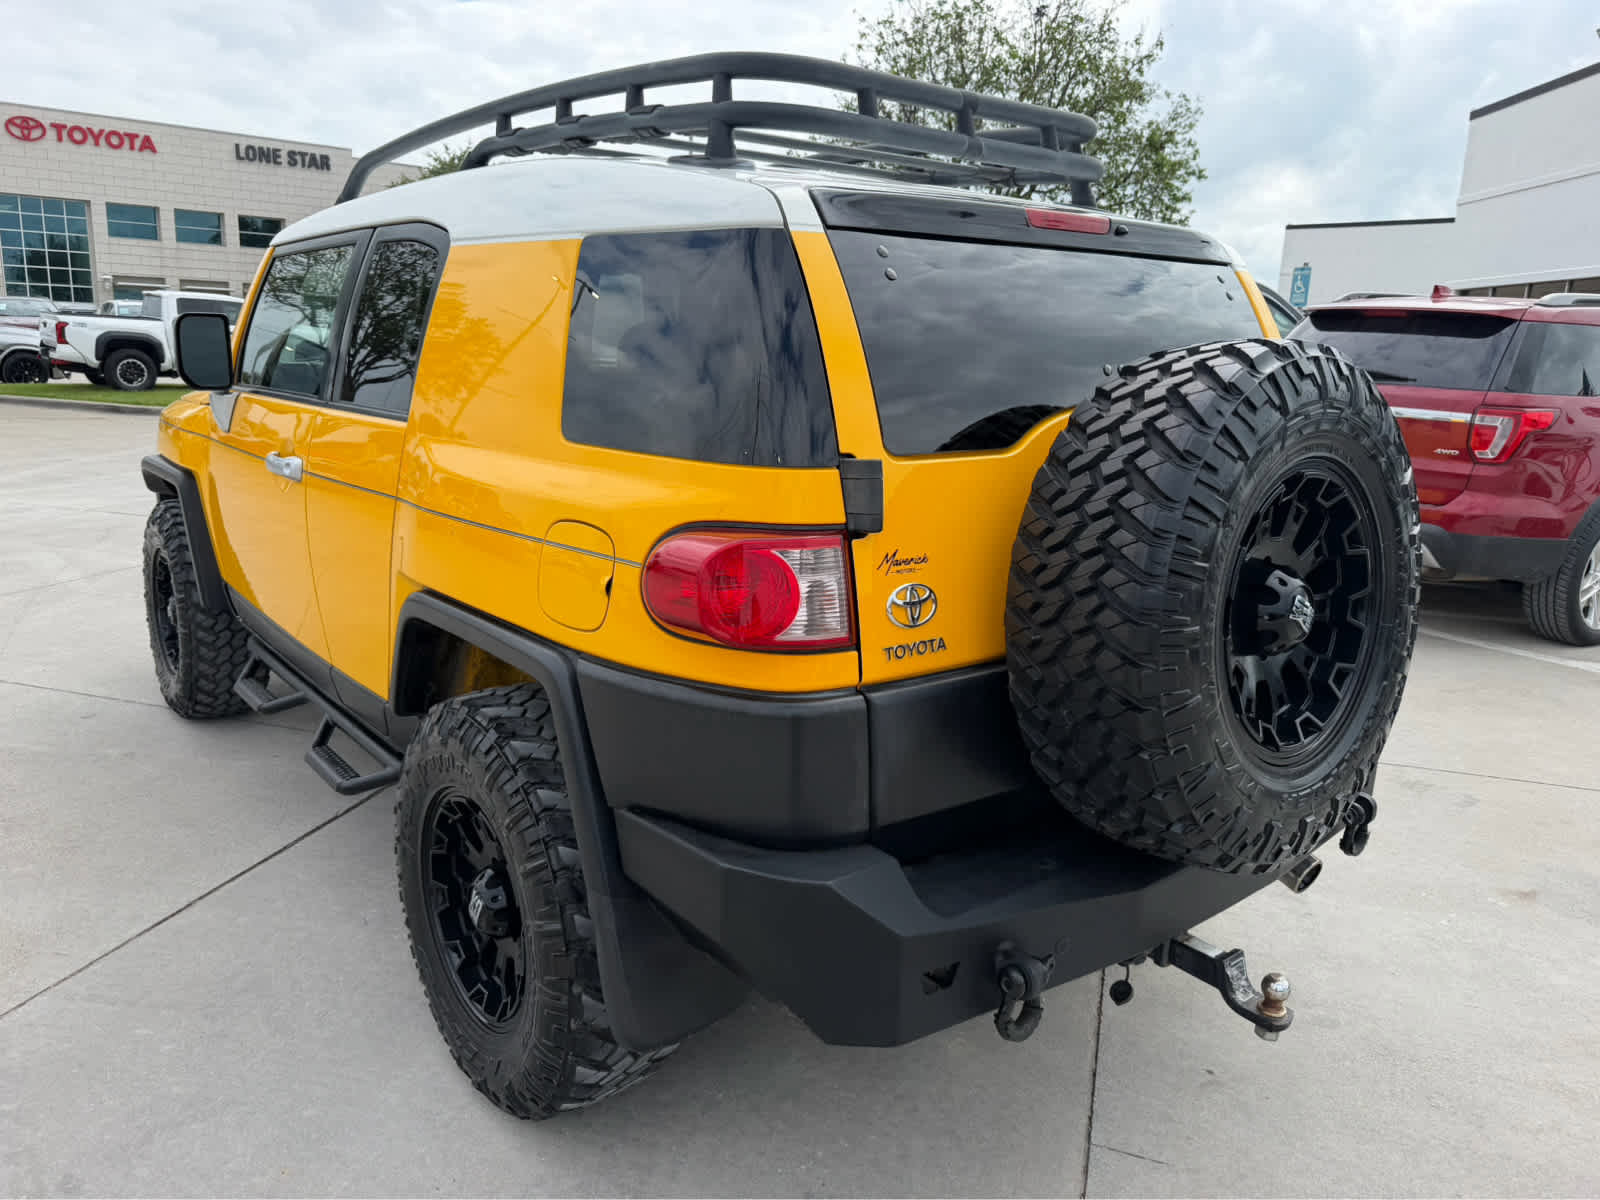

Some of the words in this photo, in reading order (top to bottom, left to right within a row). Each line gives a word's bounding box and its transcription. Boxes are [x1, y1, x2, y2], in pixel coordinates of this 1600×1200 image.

[50, 122, 158, 154] TOYOTA
[235, 143, 283, 166] LONE
[287, 149, 331, 171] STAR
[876, 549, 929, 576] Maverick
[883, 637, 947, 661] TOYOTA
